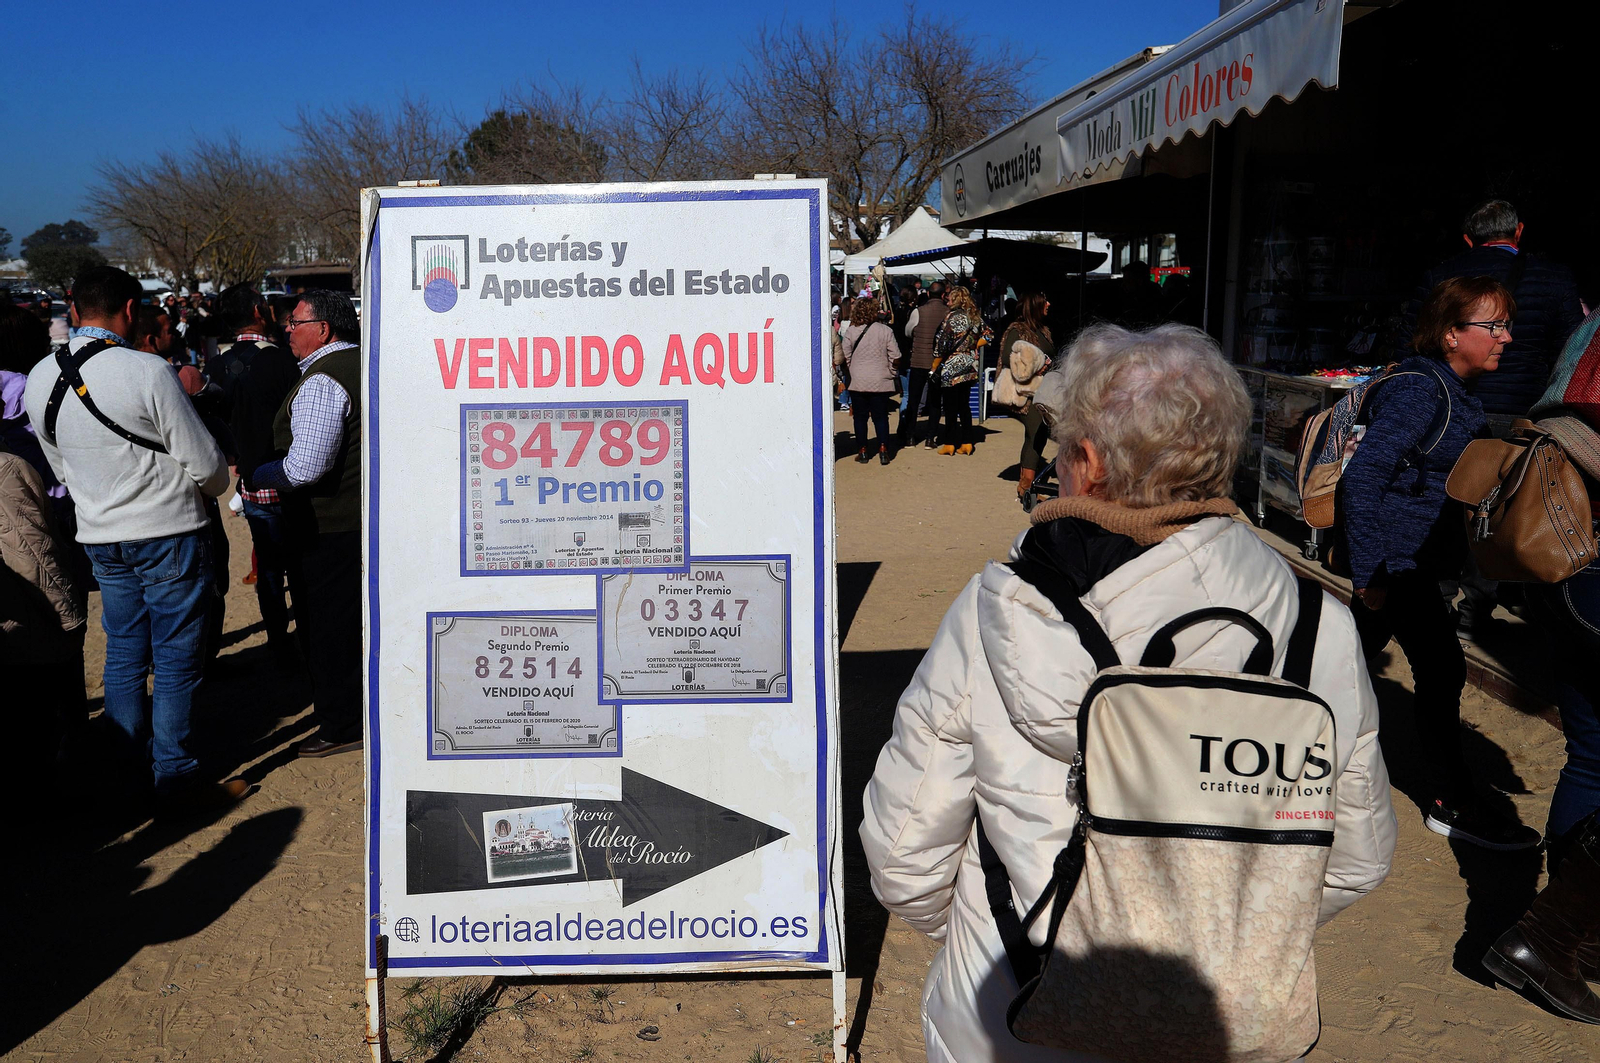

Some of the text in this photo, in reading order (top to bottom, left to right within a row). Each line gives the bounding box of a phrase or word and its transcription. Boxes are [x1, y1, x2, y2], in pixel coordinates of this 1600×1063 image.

[1085, 52, 1254, 163] Moda Mil Colores
[986, 142, 1042, 193] Carruajes
[478, 235, 628, 267] Loterías y
[480, 267, 790, 306] Apuestas del Estado
[434, 318, 775, 389] VENDIDO AQUÍ
[481, 419, 671, 470] 84789
[538, 473, 664, 505] Premio
[666, 571, 725, 582] DIPLOMA
[658, 585, 732, 595] Primer Premio
[500, 626, 558, 637] DIPLOMA
[648, 624, 741, 639] VENDIDO AQUÍ
[488, 640, 570, 654] Segundo Premio
[482, 685, 574, 699] VENDIDO AQUÍ
[671, 683, 706, 691] LOTERÍAS
[1189, 734, 1332, 783] TOUS
[1200, 780, 1260, 795] crafted
[1297, 785, 1332, 797] love
[577, 825, 641, 849] Aldea
[610, 840, 696, 865] del Rocío
[430, 909, 808, 943] loteriaaldeadelrocio.es
